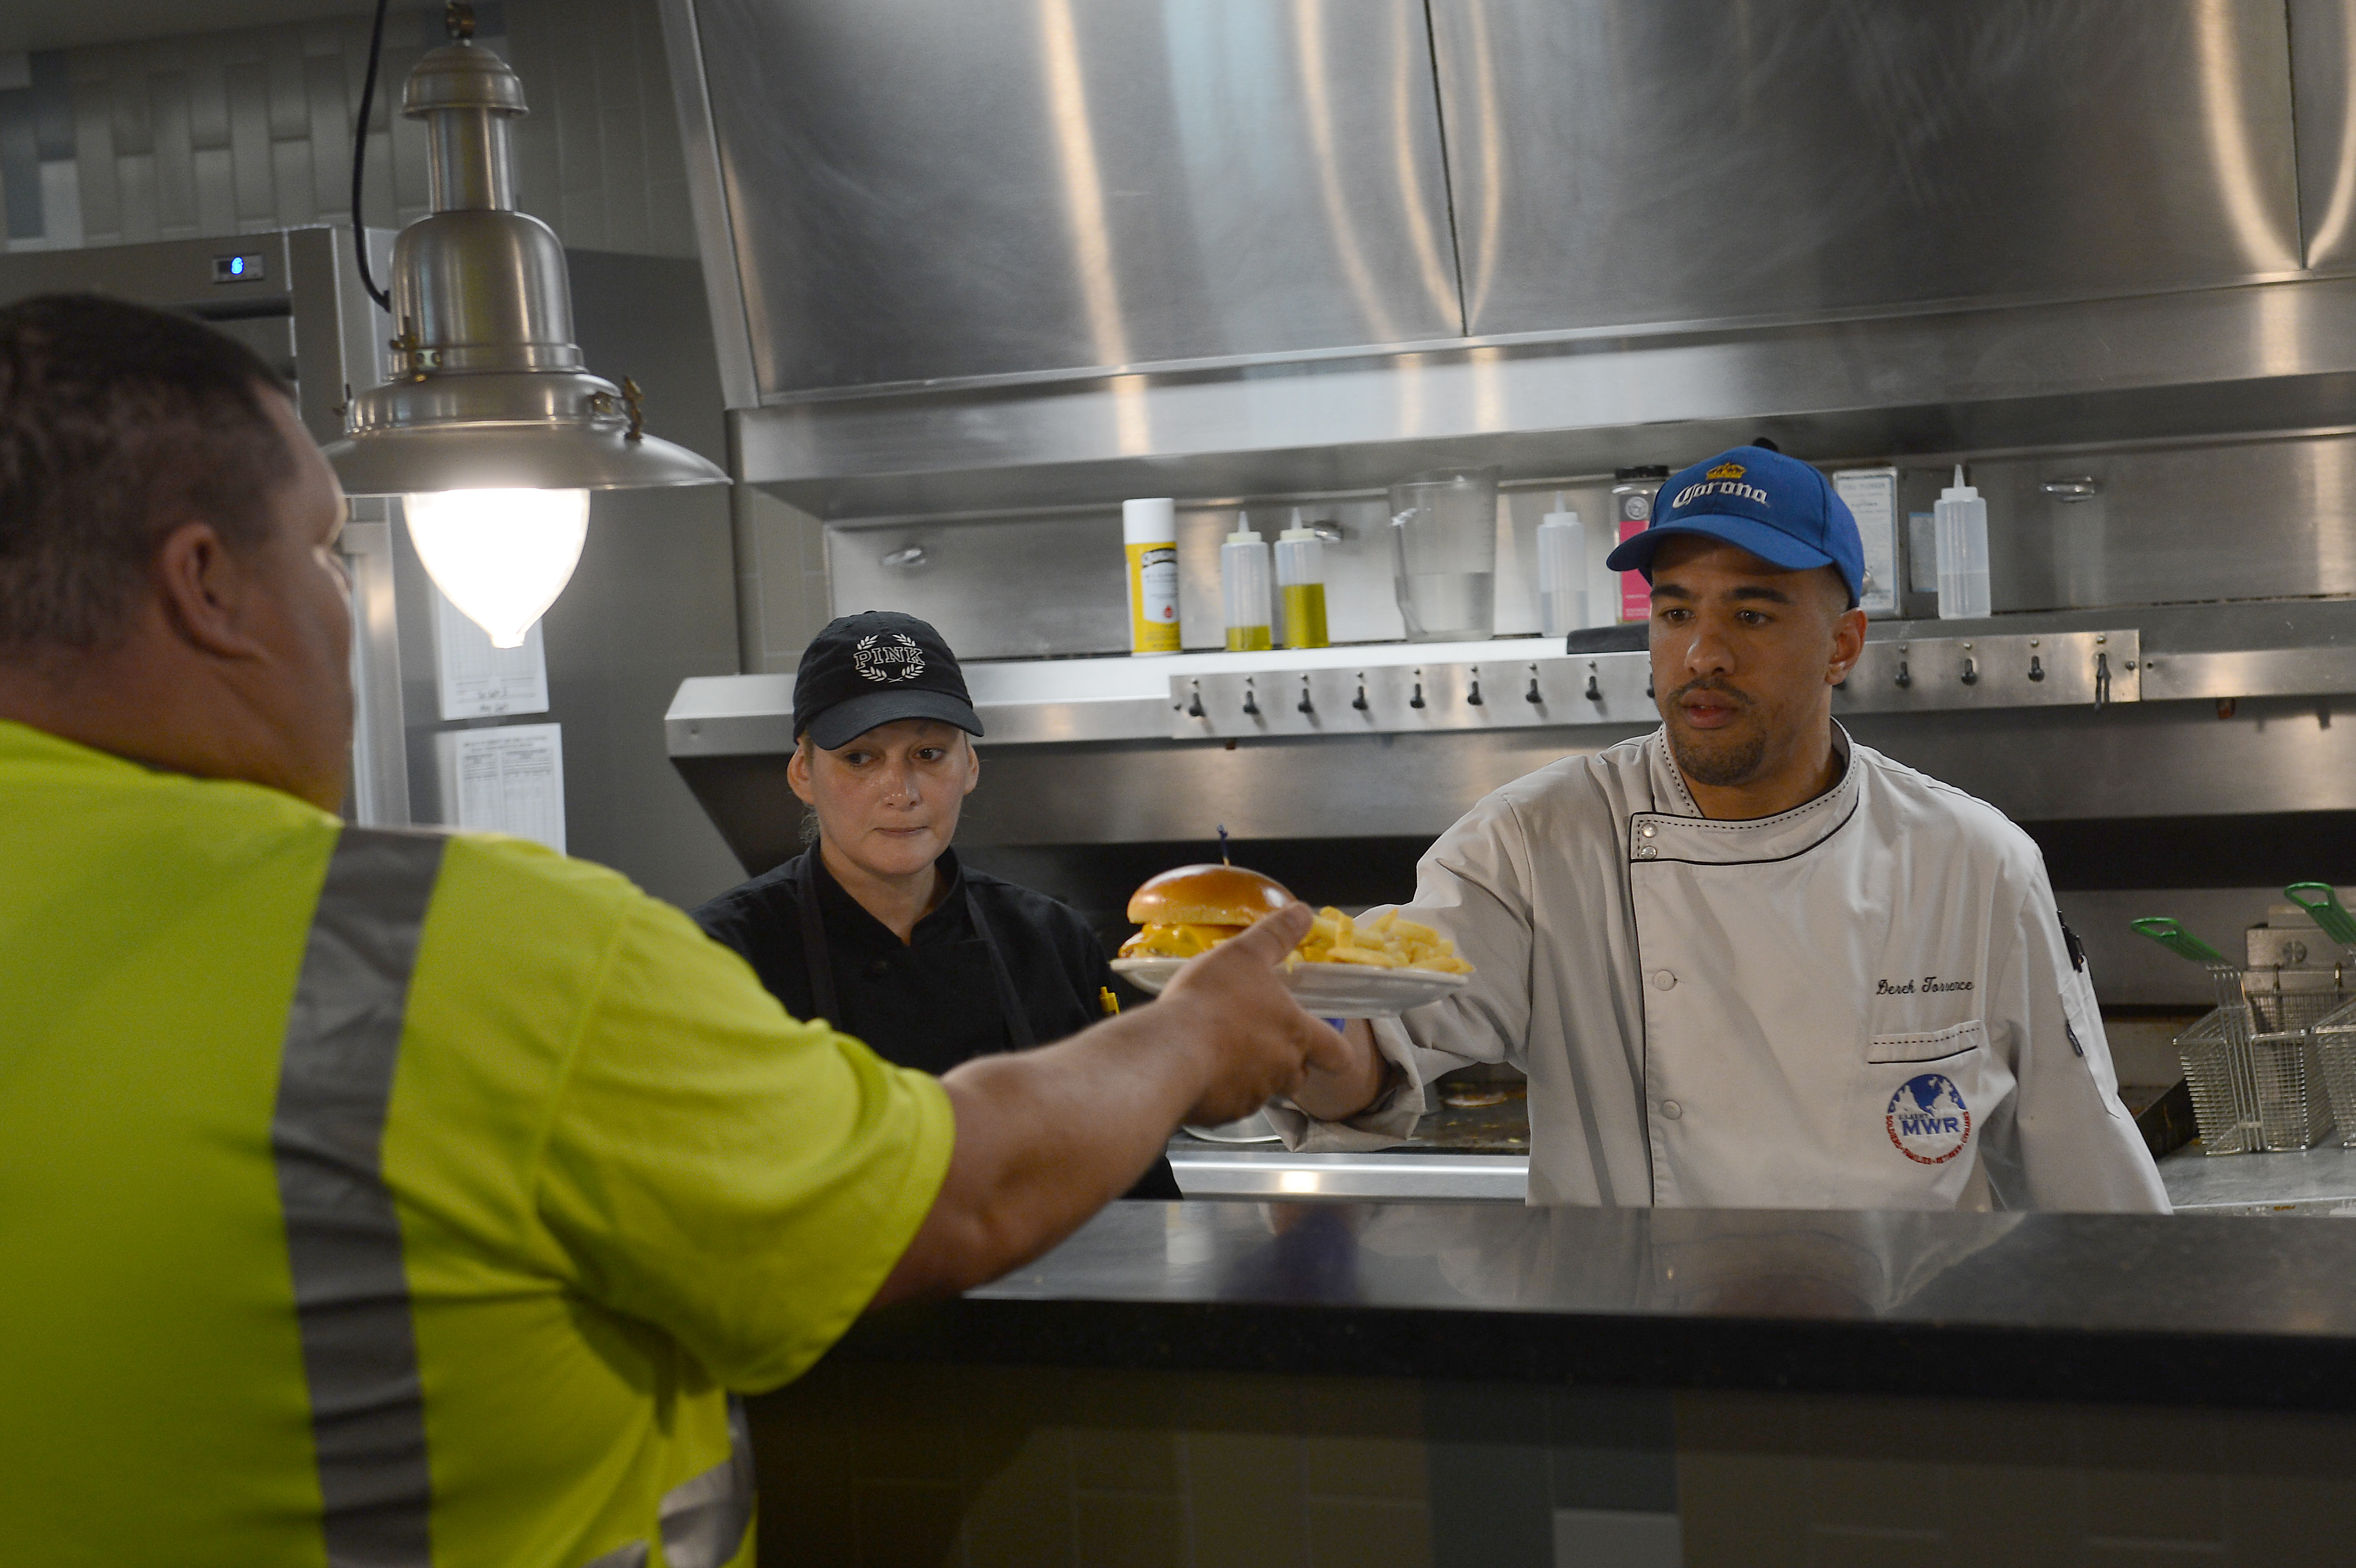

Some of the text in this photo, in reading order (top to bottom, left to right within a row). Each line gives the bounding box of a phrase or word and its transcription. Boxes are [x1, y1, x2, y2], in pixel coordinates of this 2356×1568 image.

[1672, 481, 1768, 509] Corona
[853, 646, 926, 670] PINK
[1876, 979, 1916, 995] Derek
[1902, 1117, 1961, 1136] MWR
